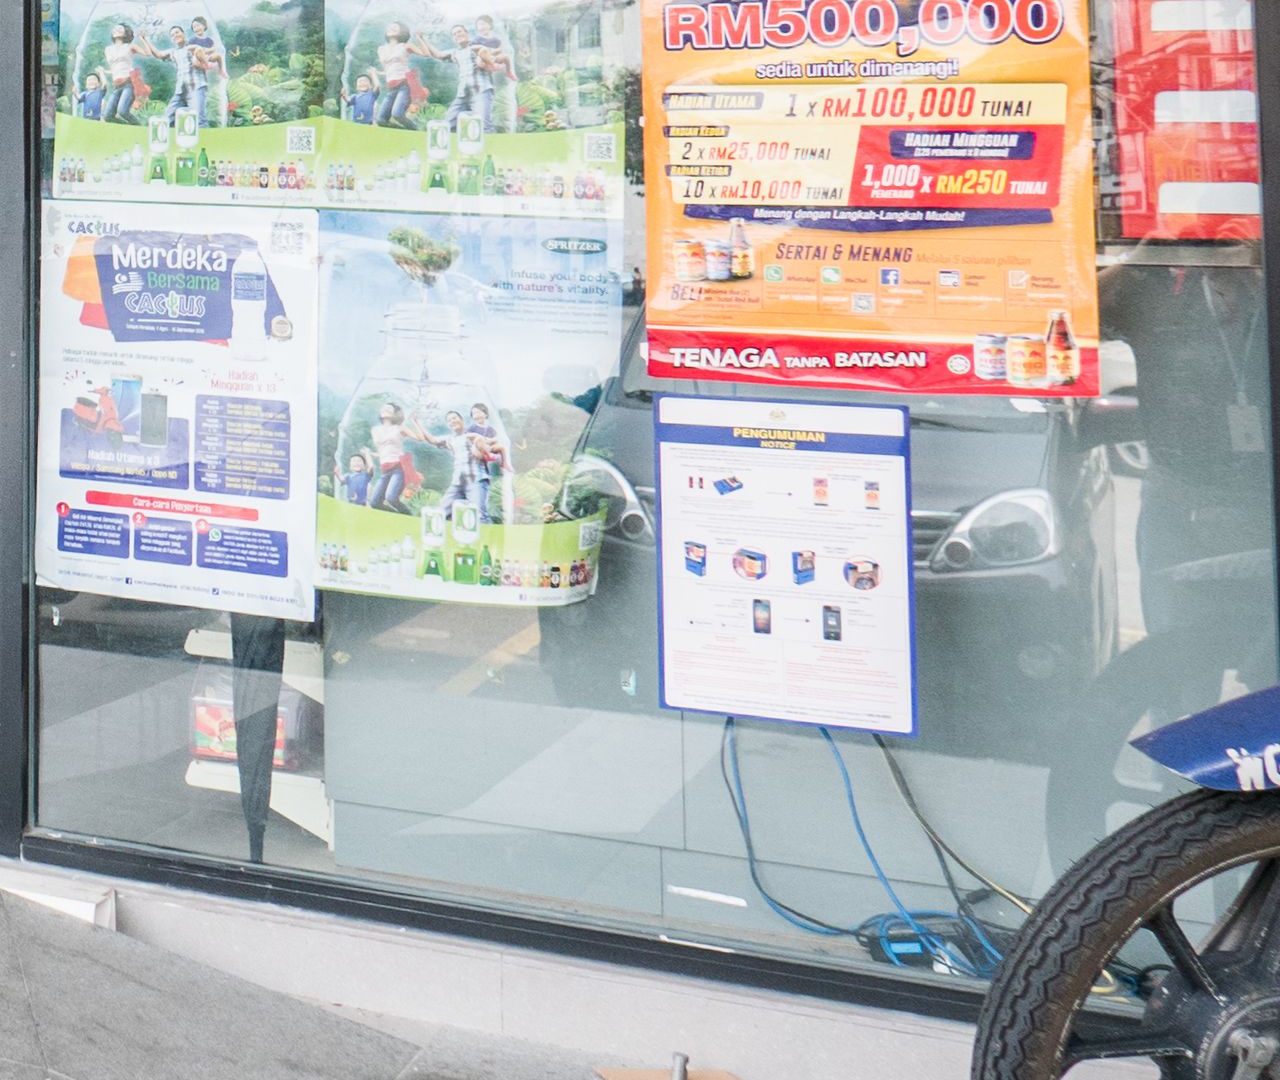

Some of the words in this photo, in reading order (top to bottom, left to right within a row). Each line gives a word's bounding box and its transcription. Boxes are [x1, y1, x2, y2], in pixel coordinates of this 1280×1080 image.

[755, 62, 803, 80] sedia
[806, 60, 856, 79] untuk
[858, 58, 960, 80] dimenangi!
[785, 94, 797, 118] 1
[822, 87, 976, 121] RM100,000
[981, 100, 1033, 117] TUNAI
[904, 132, 951, 147] HADIAH
[952, 132, 1019, 148] MINGGUAN
[682, 142, 693, 161] 2
[709, 141, 790, 162] RM25,000
[793, 147, 832, 161] TUNAI
[861, 164, 921, 189] 1,000
[936, 169, 1008, 195] RM250
[1009, 181, 1049, 195] TUNAI
[682, 180, 705, 199] 10
[720, 180, 802, 202] RM10,000
[805, 186, 845, 200] TUNAI
[753, 208, 792, 221] Menang
[793, 209, 831, 222] dengan
[833, 208, 923, 222] Langkah-Langkah
[546, 239, 605, 253] SPRITZER
[776, 242, 828, 261] SERTAI
[832, 244, 844, 261] &
[847, 245, 913, 263] MENANG
[112, 243, 227, 273] Merdeka
[147, 271, 220, 292] Bersama
[510, 269, 547, 281] Infuse
[516, 282, 564, 295] nature's
[124, 291, 206, 319] CACTUS
[669, 347, 781, 369] TENAGA
[784, 356, 830, 368] TANPA
[834, 352, 927, 368] BATASAN
[732, 427, 826, 443] PENGUMUMAN
[760, 440, 796, 450] NOTICE
